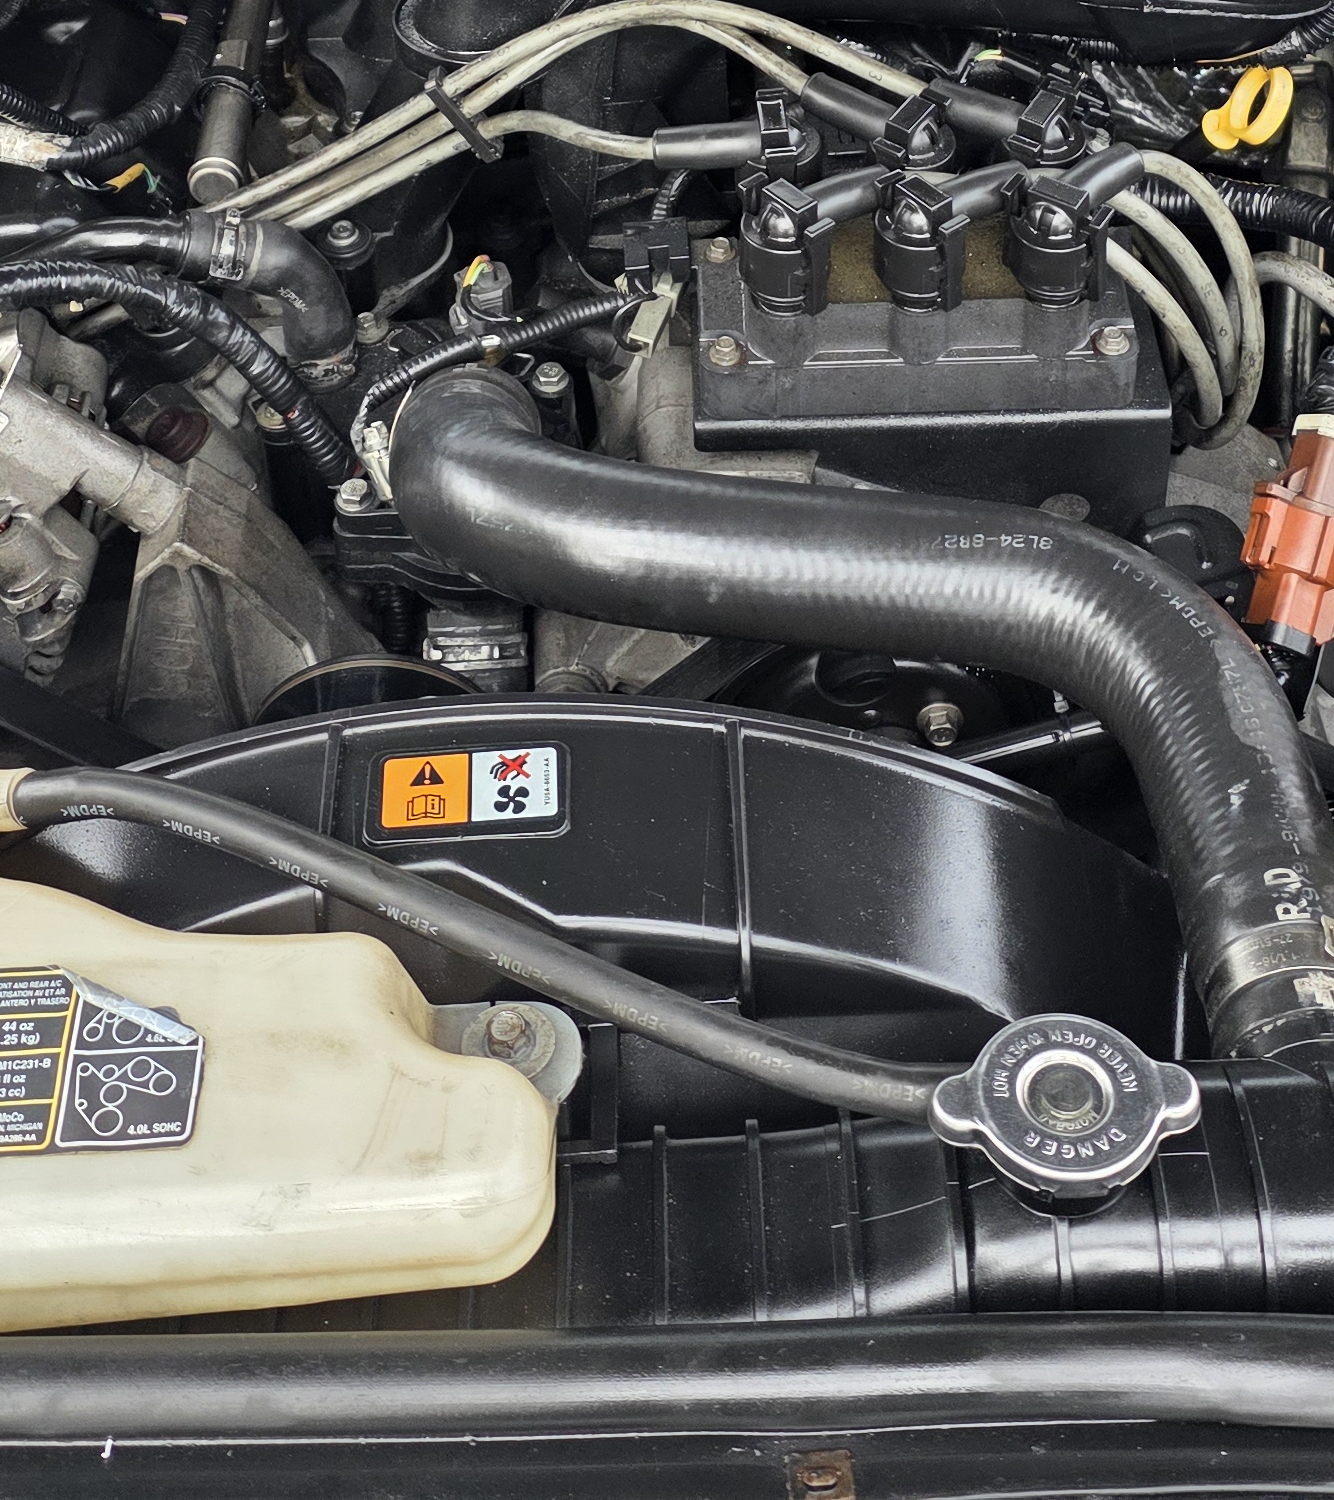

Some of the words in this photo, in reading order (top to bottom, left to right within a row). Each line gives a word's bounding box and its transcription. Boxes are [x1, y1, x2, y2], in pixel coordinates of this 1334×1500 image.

[37, 997, 70, 1006] TRASERO
[2, 1022, 16, 1031] 44
[20, 1022, 34, 1031] oz
[21, 1033, 40, 1046] kg)
[145, 1034, 164, 1043] 4.6L
[1048, 1029, 1097, 1050] OPEN
[1000, 1031, 1044, 1066] WHEN
[1096, 1042, 1139, 1093] NEVER
[4, 1075, 11, 1084] fl
[14, 1075, 26, 1084] oz
[991, 1067, 1010, 1099] HOT
[8, 1086, 25, 1098] cc)
[127, 1124, 150, 1135] 4.0L
[152, 1122, 181, 1133] SOHC
[1023, 1127, 1127, 1159] DANGER
